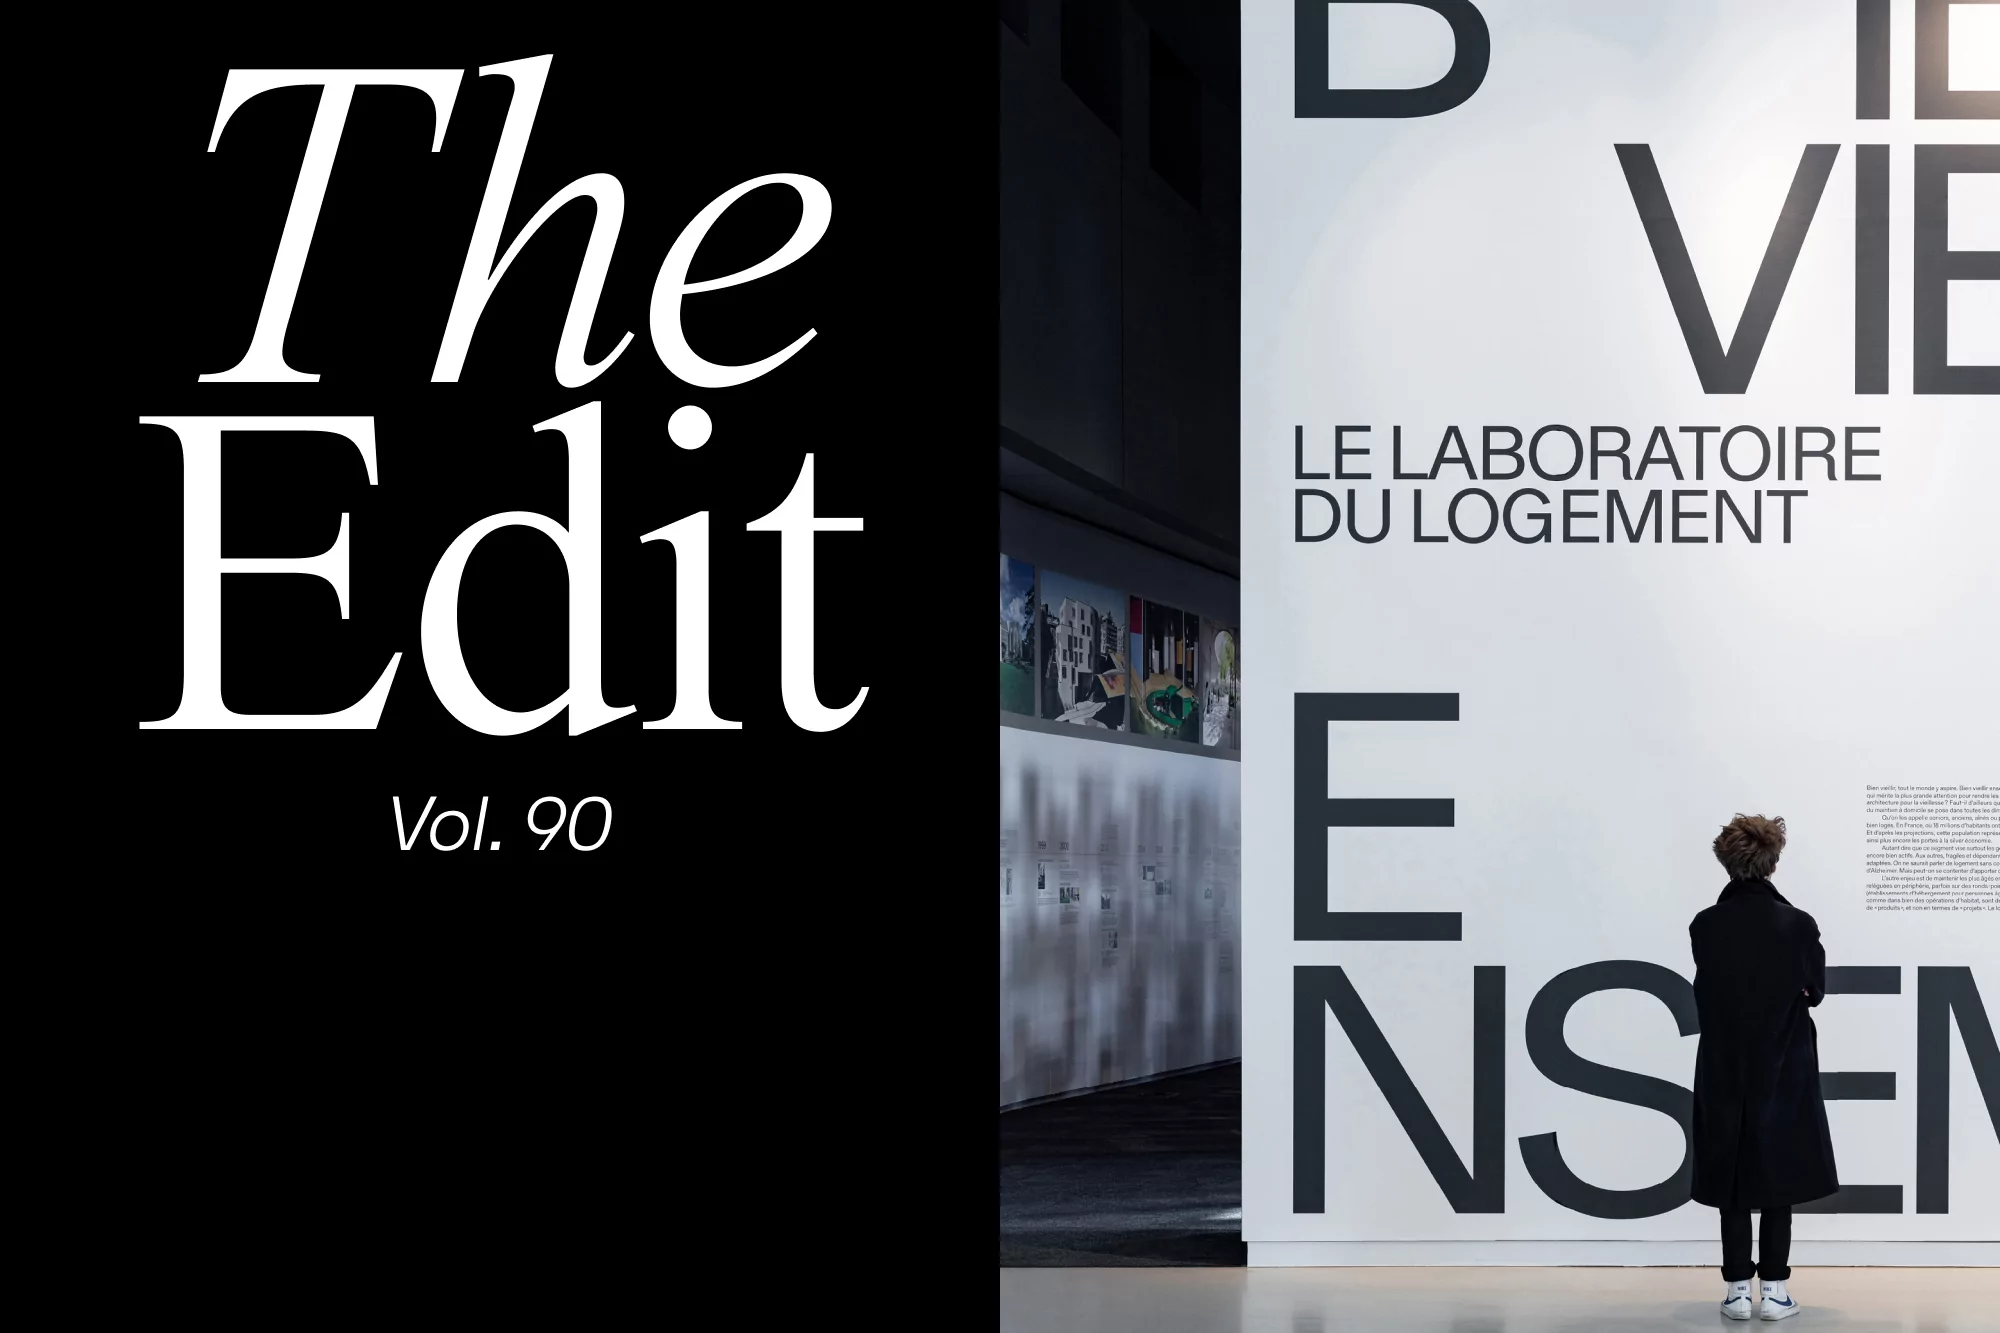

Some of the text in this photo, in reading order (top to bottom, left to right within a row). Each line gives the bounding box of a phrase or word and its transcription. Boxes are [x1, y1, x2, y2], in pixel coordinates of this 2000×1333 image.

[1294, 424, 1882, 482] LE LABORATOIRE
[1294, 488, 1808, 545] DU LOGEMENT
[1293, 692, 1462, 941] E
